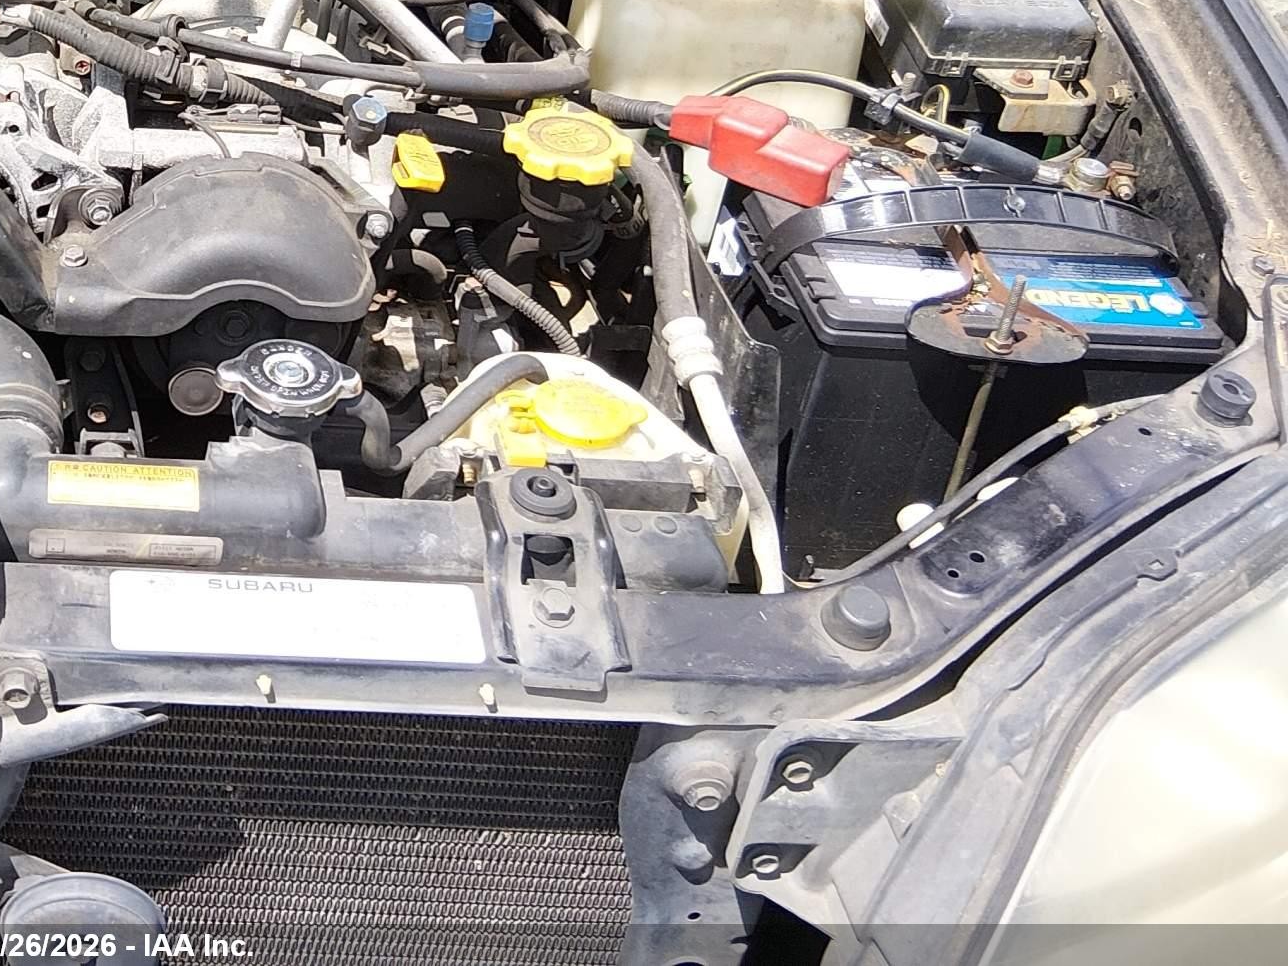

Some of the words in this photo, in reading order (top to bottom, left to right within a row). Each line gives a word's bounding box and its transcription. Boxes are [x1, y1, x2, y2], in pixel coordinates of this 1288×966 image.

[1025, 289, 1152, 313] LEGEND
[82, 464, 127, 475] CAUTION
[133, 467, 193, 477] ATTENTION
[208, 578, 313, 593] SUBARU
